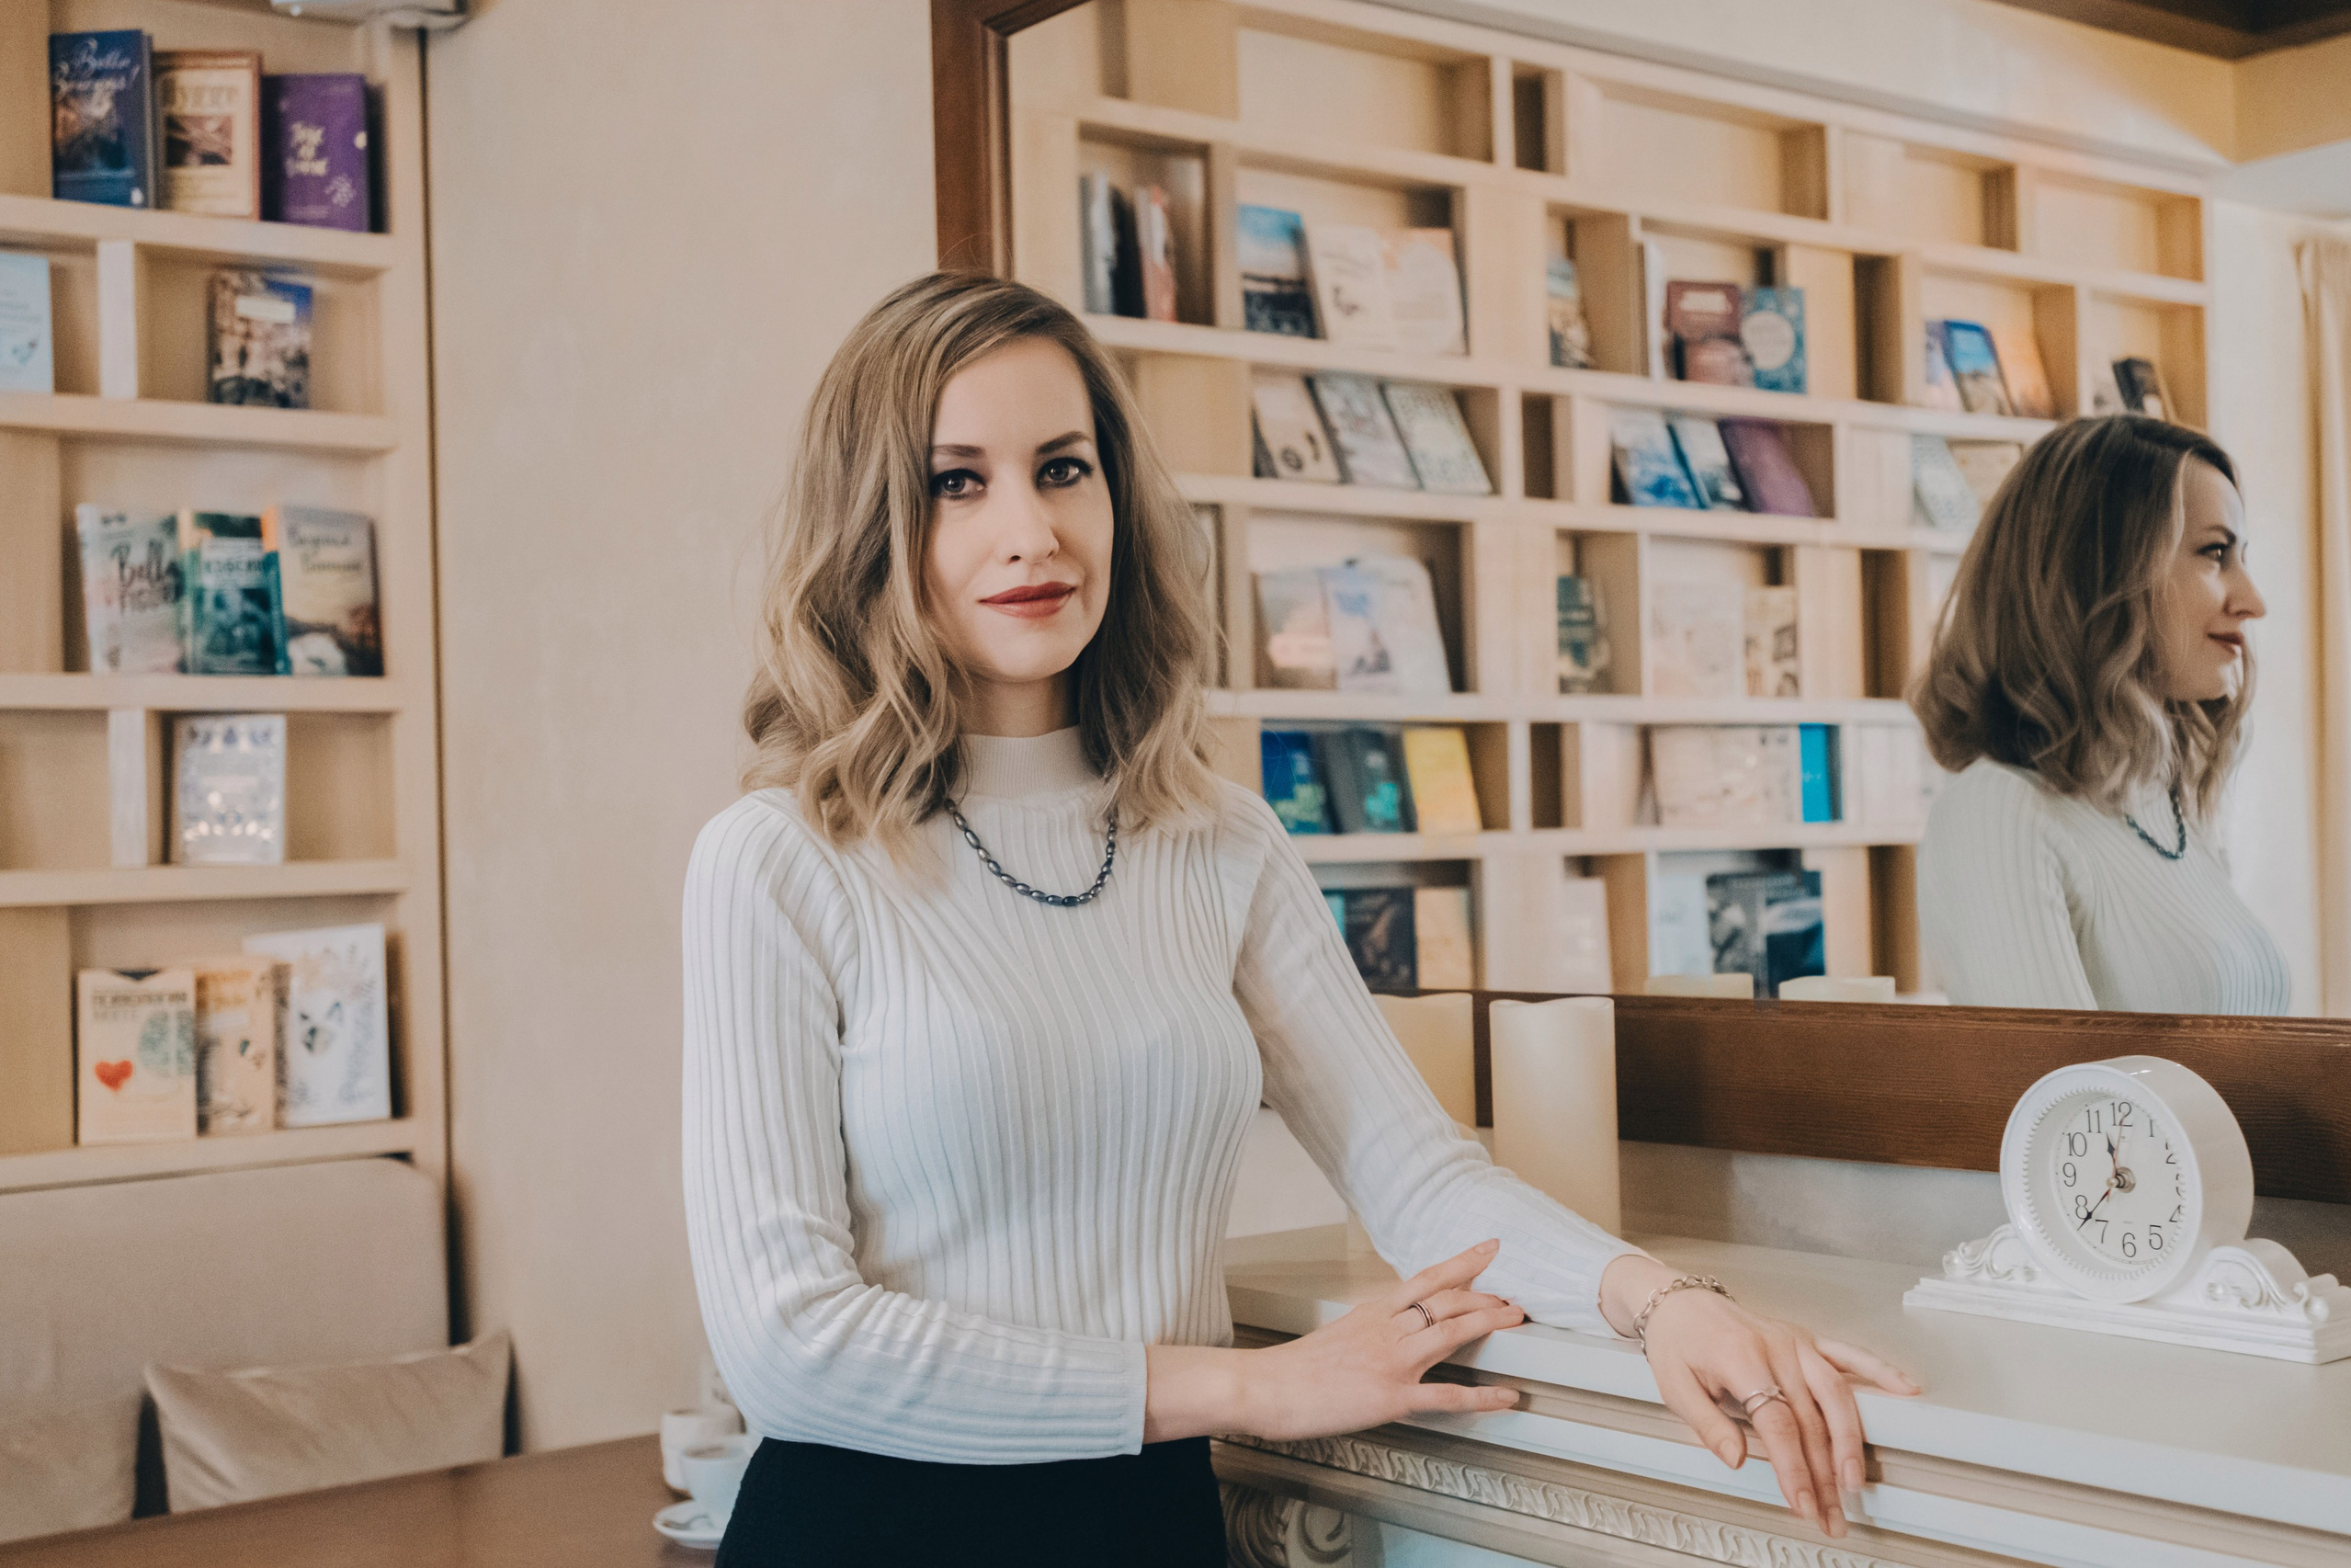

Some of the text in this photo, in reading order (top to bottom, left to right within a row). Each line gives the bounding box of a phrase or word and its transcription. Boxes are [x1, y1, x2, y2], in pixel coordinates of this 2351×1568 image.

[2085, 1108, 2102, 1134] 11
[2110, 1101, 2133, 1127] 12
[2149, 1119, 2154, 1138] 1
[2067, 1131, 2087, 1157] 10
[2062, 1162, 2076, 1187] 9
[2075, 1194, 2089, 1221] 8
[2095, 1219, 2109, 1244] 7
[2122, 1232, 2137, 1257] 6
[2149, 1224, 2164, 1250] 5
